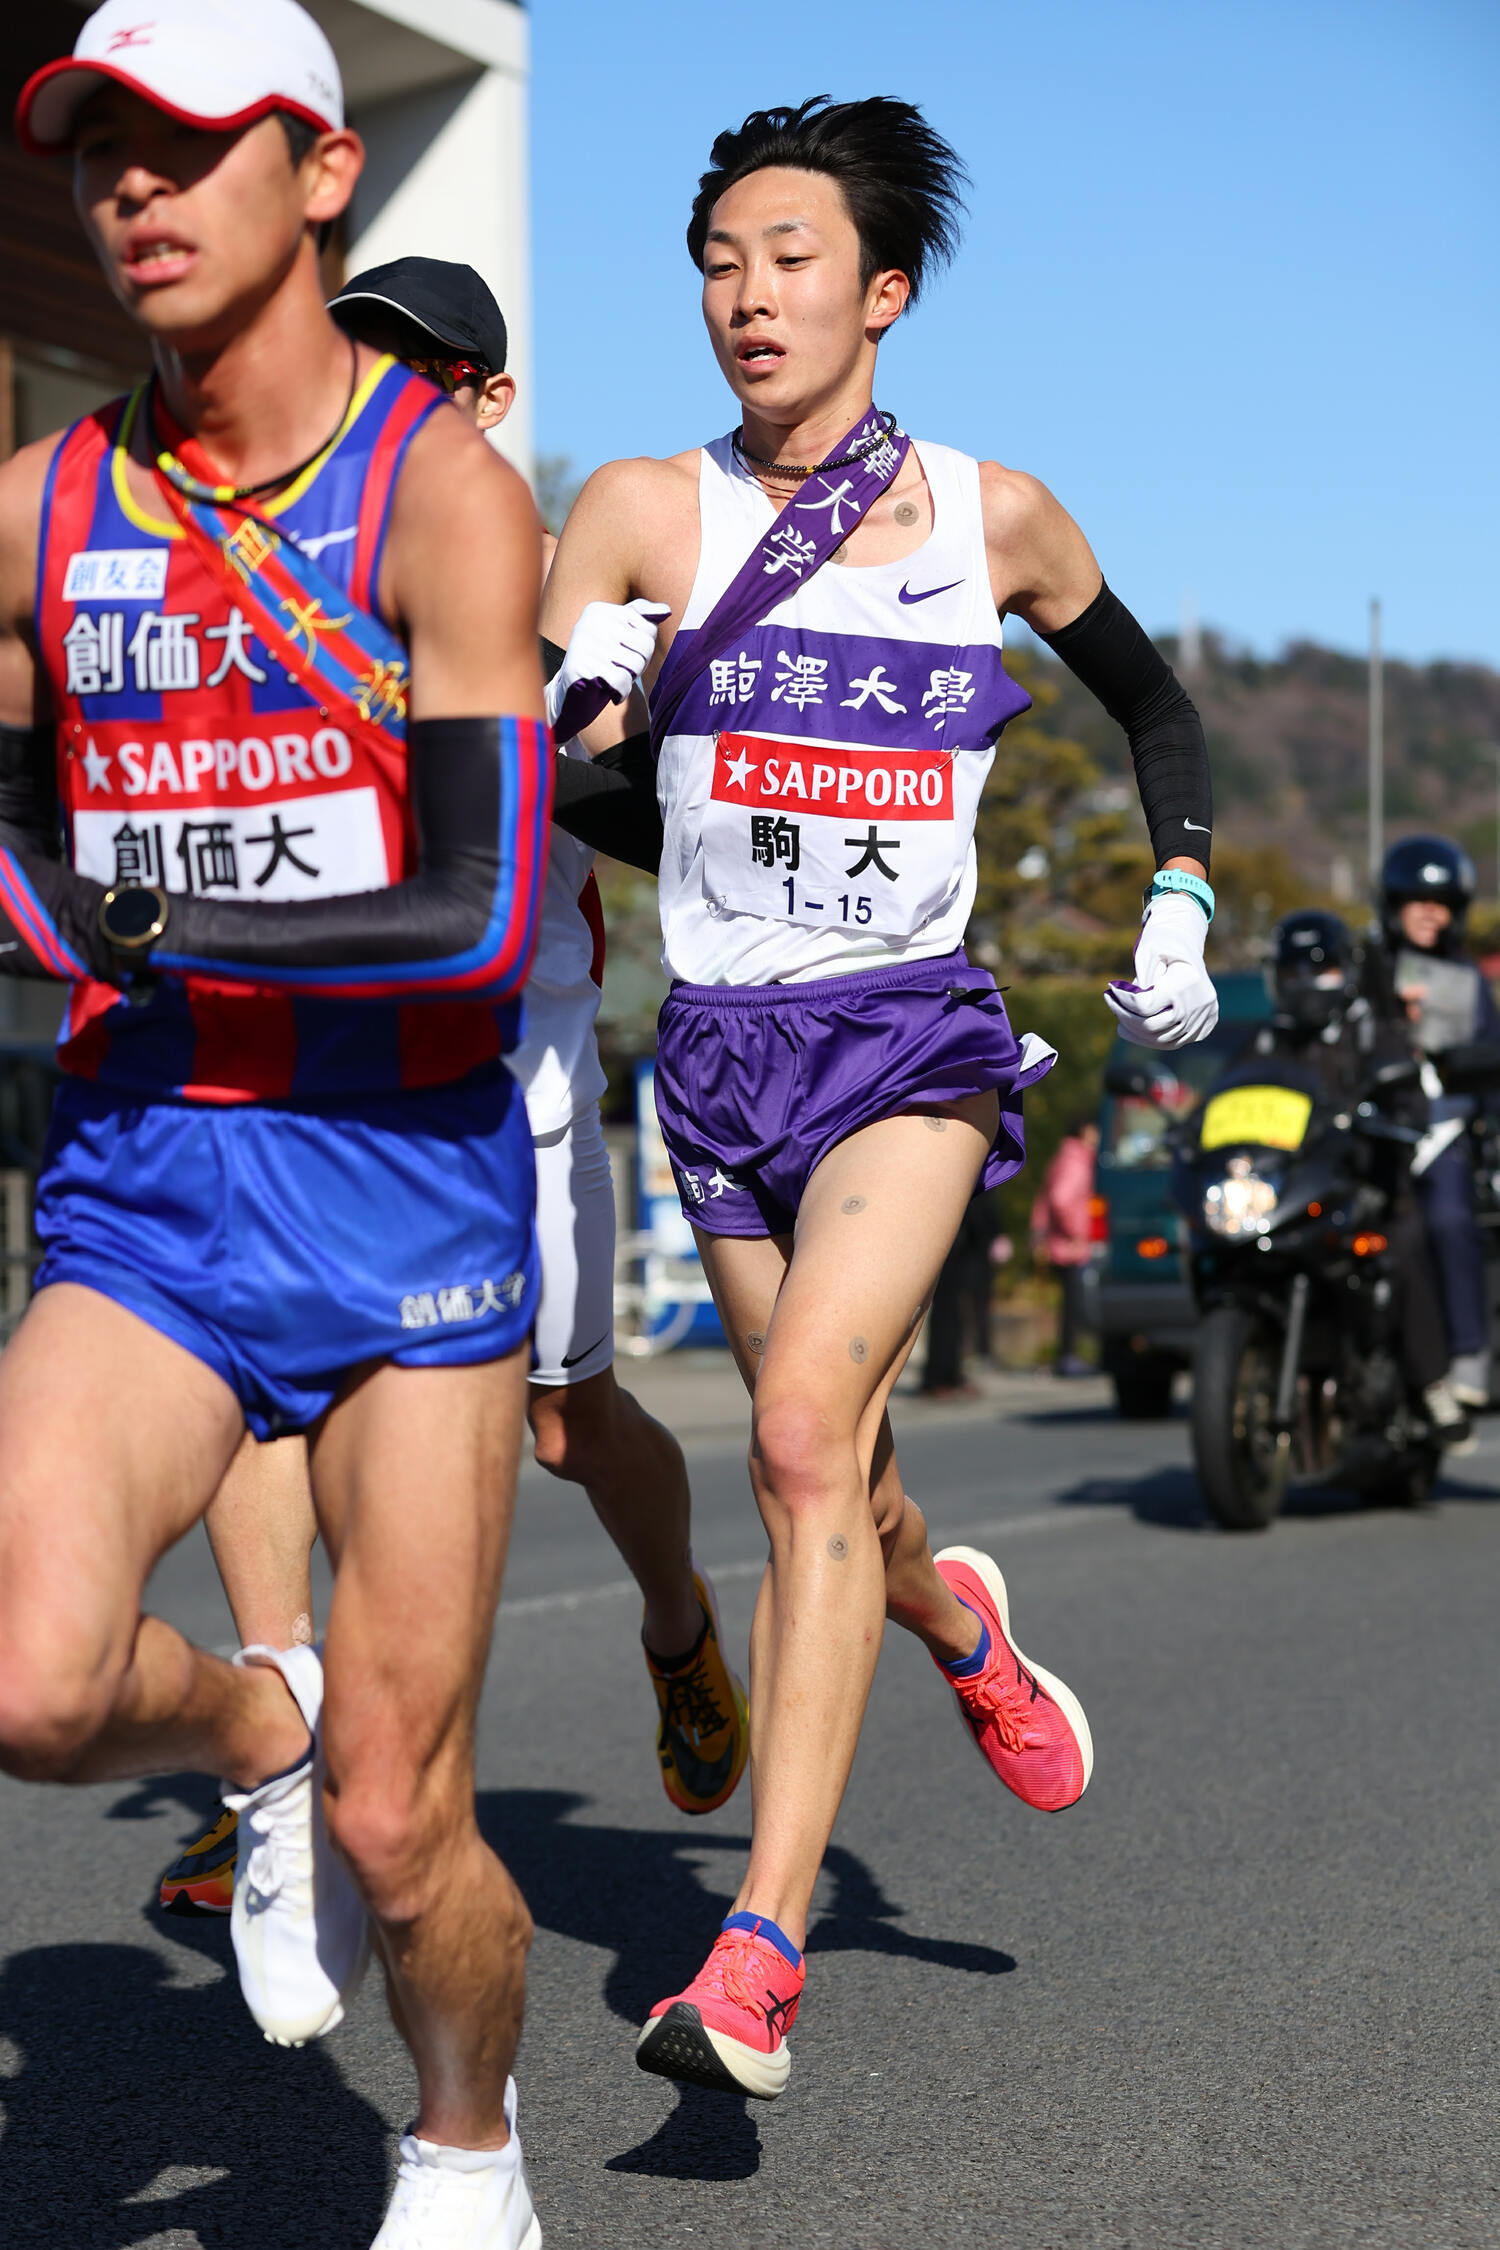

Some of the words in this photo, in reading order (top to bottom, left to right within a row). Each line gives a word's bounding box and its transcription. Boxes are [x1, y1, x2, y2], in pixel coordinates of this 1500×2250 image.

[761, 417, 906, 579] 澤大学
[63, 606, 299, 695] 創価大
[117, 727, 353, 797] SAPPORO
[760, 758, 944, 807] SAPPORO
[112, 813, 320, 892] 創価大
[750, 815, 901, 882] 駒大
